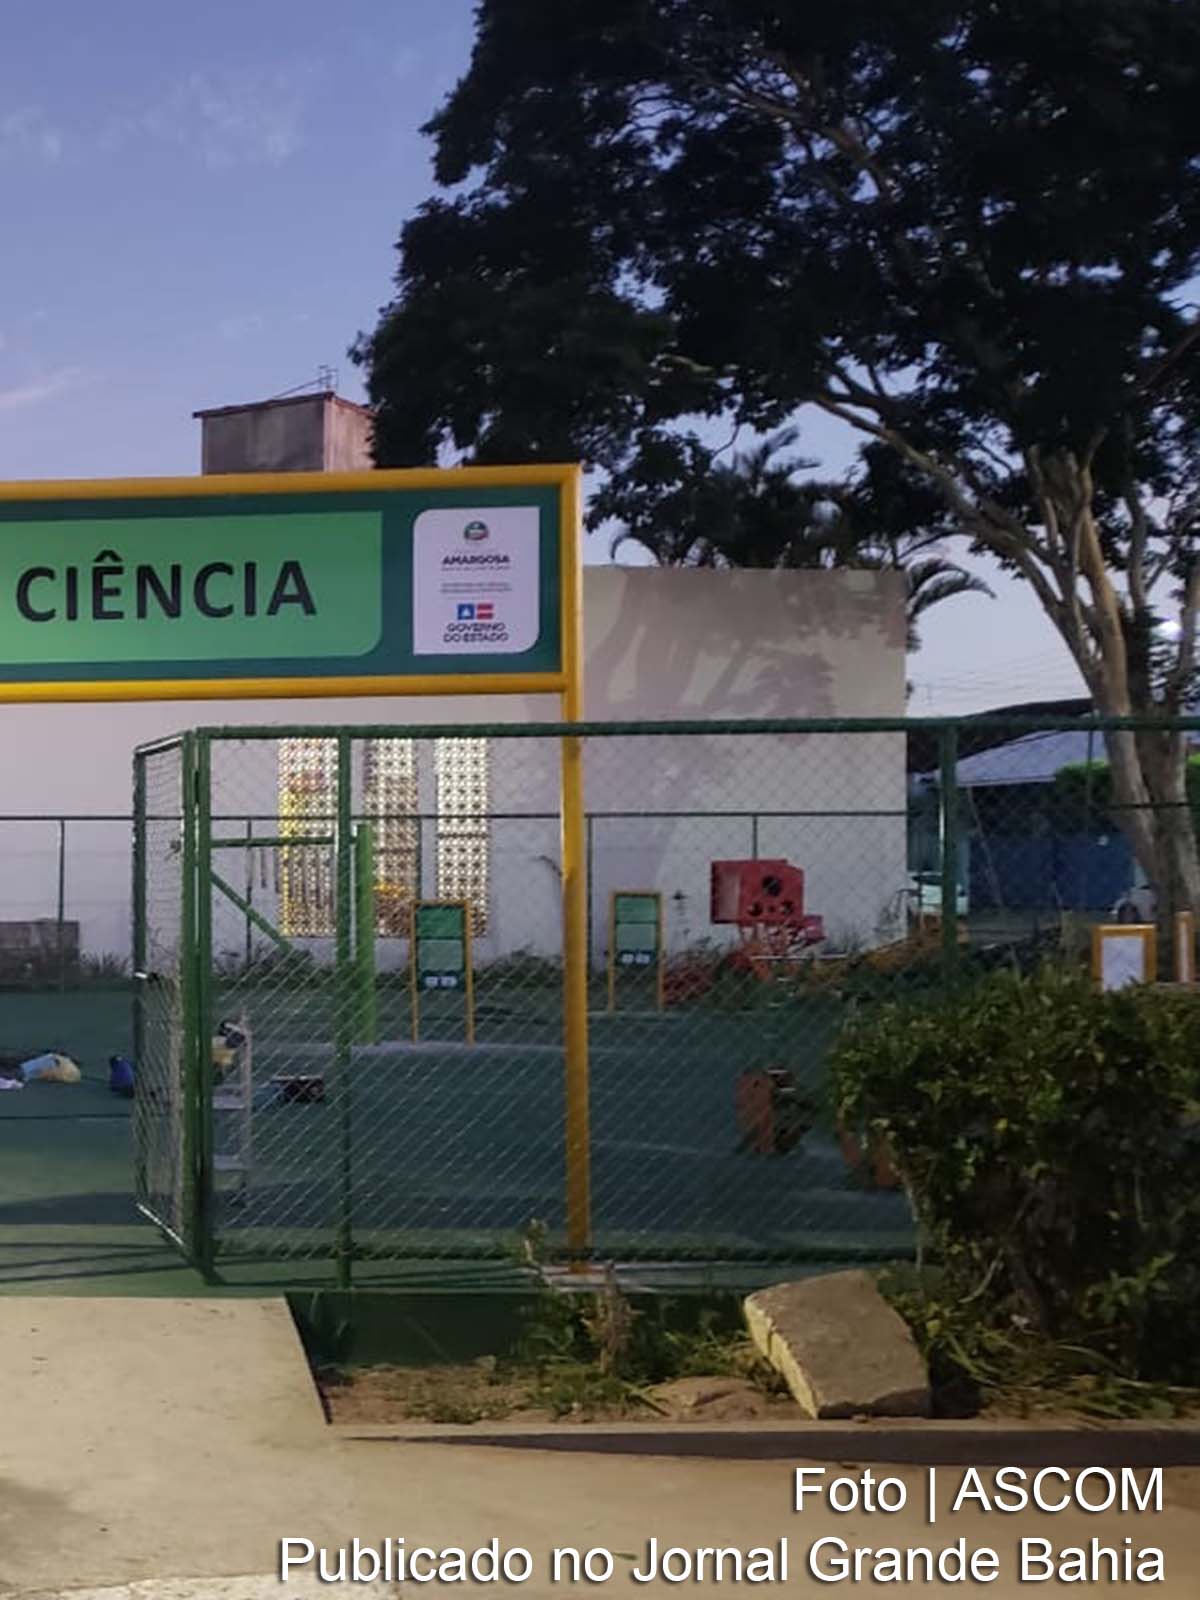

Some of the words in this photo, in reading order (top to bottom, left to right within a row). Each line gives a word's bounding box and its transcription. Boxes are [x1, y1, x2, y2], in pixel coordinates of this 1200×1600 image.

[442, 555, 510, 565] AMARGOSA
[15, 549, 318, 622] CIÊNCIA
[446, 623, 506, 632] GOVERNO
[443, 633, 461, 642] DO
[463, 632, 509, 642] ESTADO
